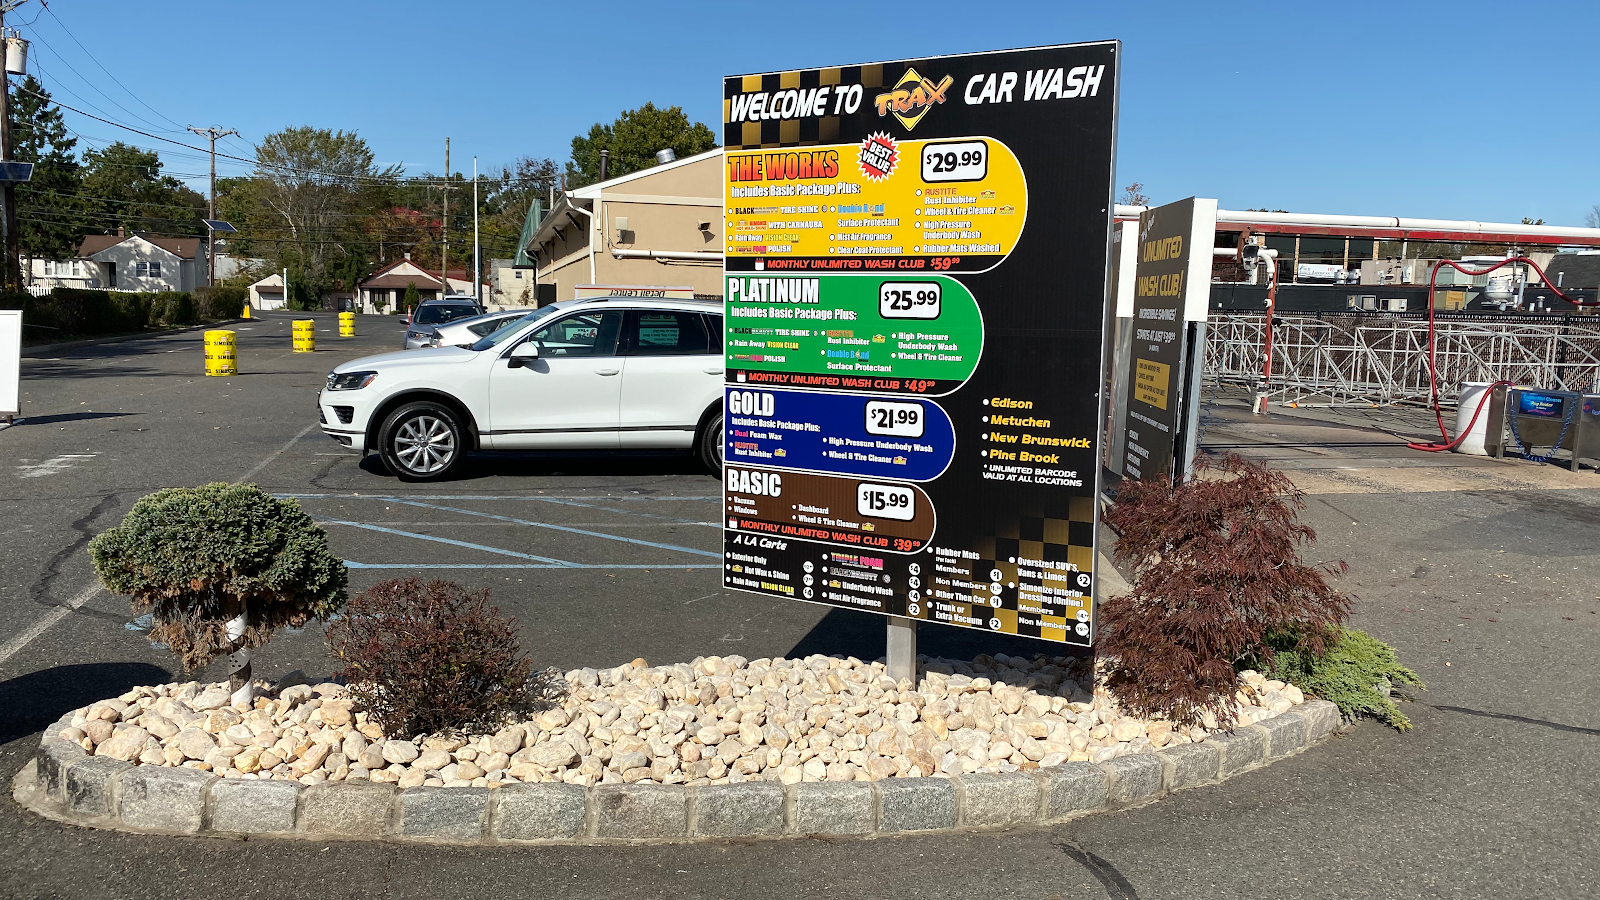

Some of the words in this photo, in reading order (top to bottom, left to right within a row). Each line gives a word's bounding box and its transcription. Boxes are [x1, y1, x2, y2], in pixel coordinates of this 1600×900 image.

[731, 86, 830, 122] WELCOME
[834, 83, 863, 115] TO
[874, 74, 954, 117] TRAX
[964, 72, 1018, 105] CAR
[1023, 65, 1105, 101] WASH
[862, 149, 891, 173] VALUE
[868, 141, 893, 160] BEST
[926, 150, 982, 173] $29.99
[728, 154, 762, 182] THE
[765, 150, 839, 181] WORKS
[731, 185, 769, 198] Includes
[770, 184, 795, 197] Basic
[796, 183, 835, 196] Package
[837, 182, 861, 195] Plus:
[925, 188, 957, 196] RUSTITE
[798, 205, 819, 213] SHINE
[925, 207, 946, 216] Wheel
[968, 206, 997, 215] Cleaner
[768, 221, 786, 229] WITH
[787, 220, 823, 229] CARNAUBA
[838, 218, 863, 227] Surface
[864, 217, 899, 227] Protectant
[940, 220, 971, 229] Pressure
[923, 231, 960, 239] Underbody
[961, 230, 981, 239] Wash
[869, 246, 903, 254] Protectant
[923, 244, 949, 253] Rubber
[950, 244, 969, 252] Mats
[969, 243, 1000, 252] Washed
[1143, 235, 1182, 262] UNLIMITED
[767, 260, 809, 269] MONTHLY
[811, 260, 862, 269] UNLIMITED
[864, 259, 896, 269] WASH
[898, 259, 925, 269] CLUB
[1138, 275, 1159, 296] WASH
[1160, 270, 1184, 299] CLUB!
[728, 277, 819, 304] PLATINUM
[884, 290, 937, 310] $25.99
[731, 306, 768, 318] Includes
[769, 307, 793, 319] Basic
[794, 308, 833, 321] Package
[834, 309, 857, 320] Plus:
[791, 329, 810, 337] SHINE
[898, 331, 915, 341] High
[917, 332, 948, 341] Pressure
[749, 340, 765, 349] Away
[827, 337, 842, 345] Rust
[898, 342, 936, 351] Underbody
[938, 342, 958, 351] Wash
[827, 350, 850, 358] Double
[898, 352, 916, 360] Wheel
[924, 353, 937, 361] Tire
[938, 353, 963, 362] Cleaner
[827, 362, 854, 371] Surface
[855, 363, 892, 372] Protectant
[748, 373, 789, 382] MONTHLY
[791, 375, 839, 385] UNLIMITED
[842, 378, 872, 388] WASH
[874, 379, 900, 389] CLUB
[729, 390, 775, 417] GOLD
[991, 397, 1033, 409] Edison
[731, 416, 758, 427] Includes
[759, 419, 776, 428] Basic
[777, 420, 803, 431] Package
[804, 422, 821, 432] Plus:
[871, 408, 918, 428] $21.99
[990, 414, 1050, 428] Metuchen
[750, 431, 767, 439] Foam
[768, 432, 782, 440] Wax
[990, 432, 1018, 443] New
[1021, 434, 1091, 448] Brunswick
[828, 437, 844, 446] High
[845, 438, 874, 447] Pressure
[876, 440, 912, 452] Underbody
[913, 443, 933, 452] Wash
[828, 450, 847, 459] Wheel
[854, 453, 867, 461] Tire
[868, 454, 892, 463] Cleaner
[989, 449, 1016, 460] Pine
[1020, 451, 1060, 464] Brook
[989, 464, 1033, 474] UNLIMITED
[1034, 468, 1077, 478] BARCODE
[982, 471, 1005, 480] VALID
[1006, 474, 1017, 482] AT
[1018, 475, 1032, 483] ALL
[1034, 477, 1083, 487] LOCATIONS
[727, 468, 782, 497] BASIC
[863, 490, 909, 510] $15.99
[734, 496, 755, 505] Vacuum
[734, 505, 758, 515] Windows
[798, 504, 829, 515] Dashboard
[798, 514, 816, 524] Wheel
[823, 517, 836, 526] Tire
[836, 518, 859, 529] Cleaner
[740, 520, 780, 532] MONTHLY
[781, 525, 829, 539] UNLIMITED
[832, 531, 861, 543] WASH
[863, 536, 888, 547] CLUB
[733, 534, 742, 544] A
[744, 535, 757, 546] LA
[759, 538, 787, 551] Carte
[732, 552, 753, 562] Exterior
[754, 555, 767, 565] Only
[935, 547, 961, 558] Rubber
[962, 550, 980, 560] Mats
[860, 556, 883, 568] FOAM
[1017, 556, 1054, 569] Oversized
[745, 565, 754, 574] Hot
[755, 567, 767, 577] Wax
[773, 570, 789, 580] Shine
[936, 564, 970, 575] Members
[1017, 568, 1036, 578] Vans
[1044, 571, 1067, 582] Limos
[732, 576, 744, 585] Rain
[745, 578, 759, 588] Away
[761, 581, 778, 591] VISION
[842, 581, 876, 593] Underbody
[876, 585, 893, 596] Wash
[936, 577, 950, 585] Non
[952, 579, 987, 590] Members
[1019, 582, 1053, 594] Simonize
[1054, 587, 1083, 598] Interior
[829, 592, 842, 601] Mist
[842, 593, 851, 602] Air
[851, 595, 882, 607] Fragrance
[935, 589, 954, 600] Other
[955, 592, 972, 602] Then
[973, 595, 986, 604] Car
[1019, 591, 1052, 604] Dressing
[936, 601, 956, 612] Trunk
[1019, 604, 1054, 615] Members
[935, 611, 953, 621] Extra
[954, 613, 983, 625] Vacuum
[1018, 617, 1034, 626] Non
[1036, 619, 1071, 631] Members
